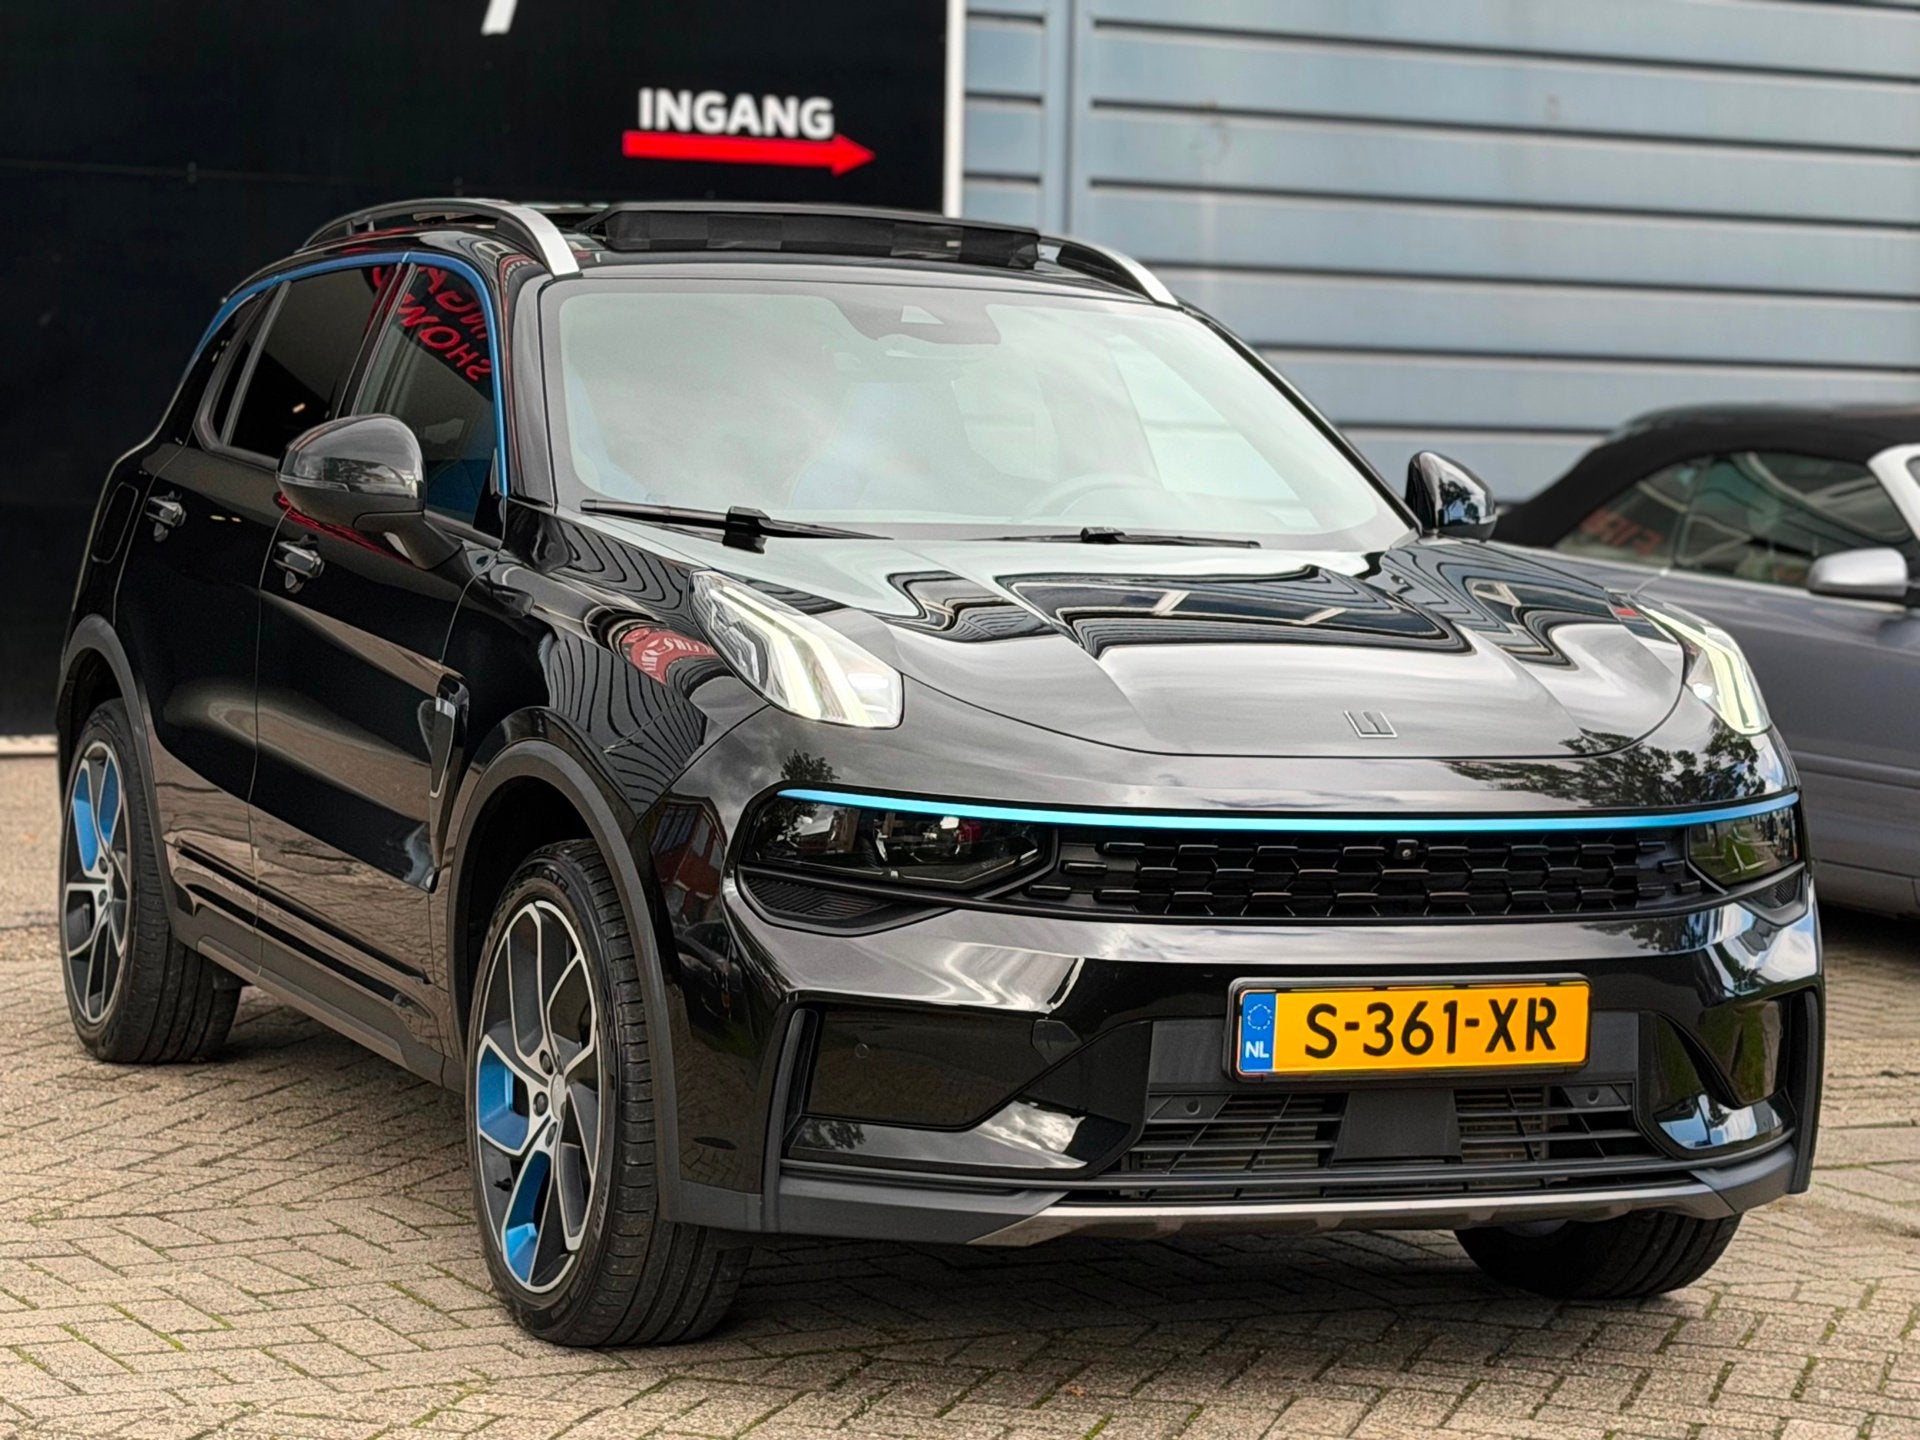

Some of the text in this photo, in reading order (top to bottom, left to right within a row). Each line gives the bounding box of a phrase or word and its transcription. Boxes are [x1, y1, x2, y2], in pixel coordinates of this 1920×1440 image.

[637, 87, 835, 140] INGANG
[1244, 1041, 1270, 1059] NL
[1305, 997, 1557, 1059] S-361-XR
